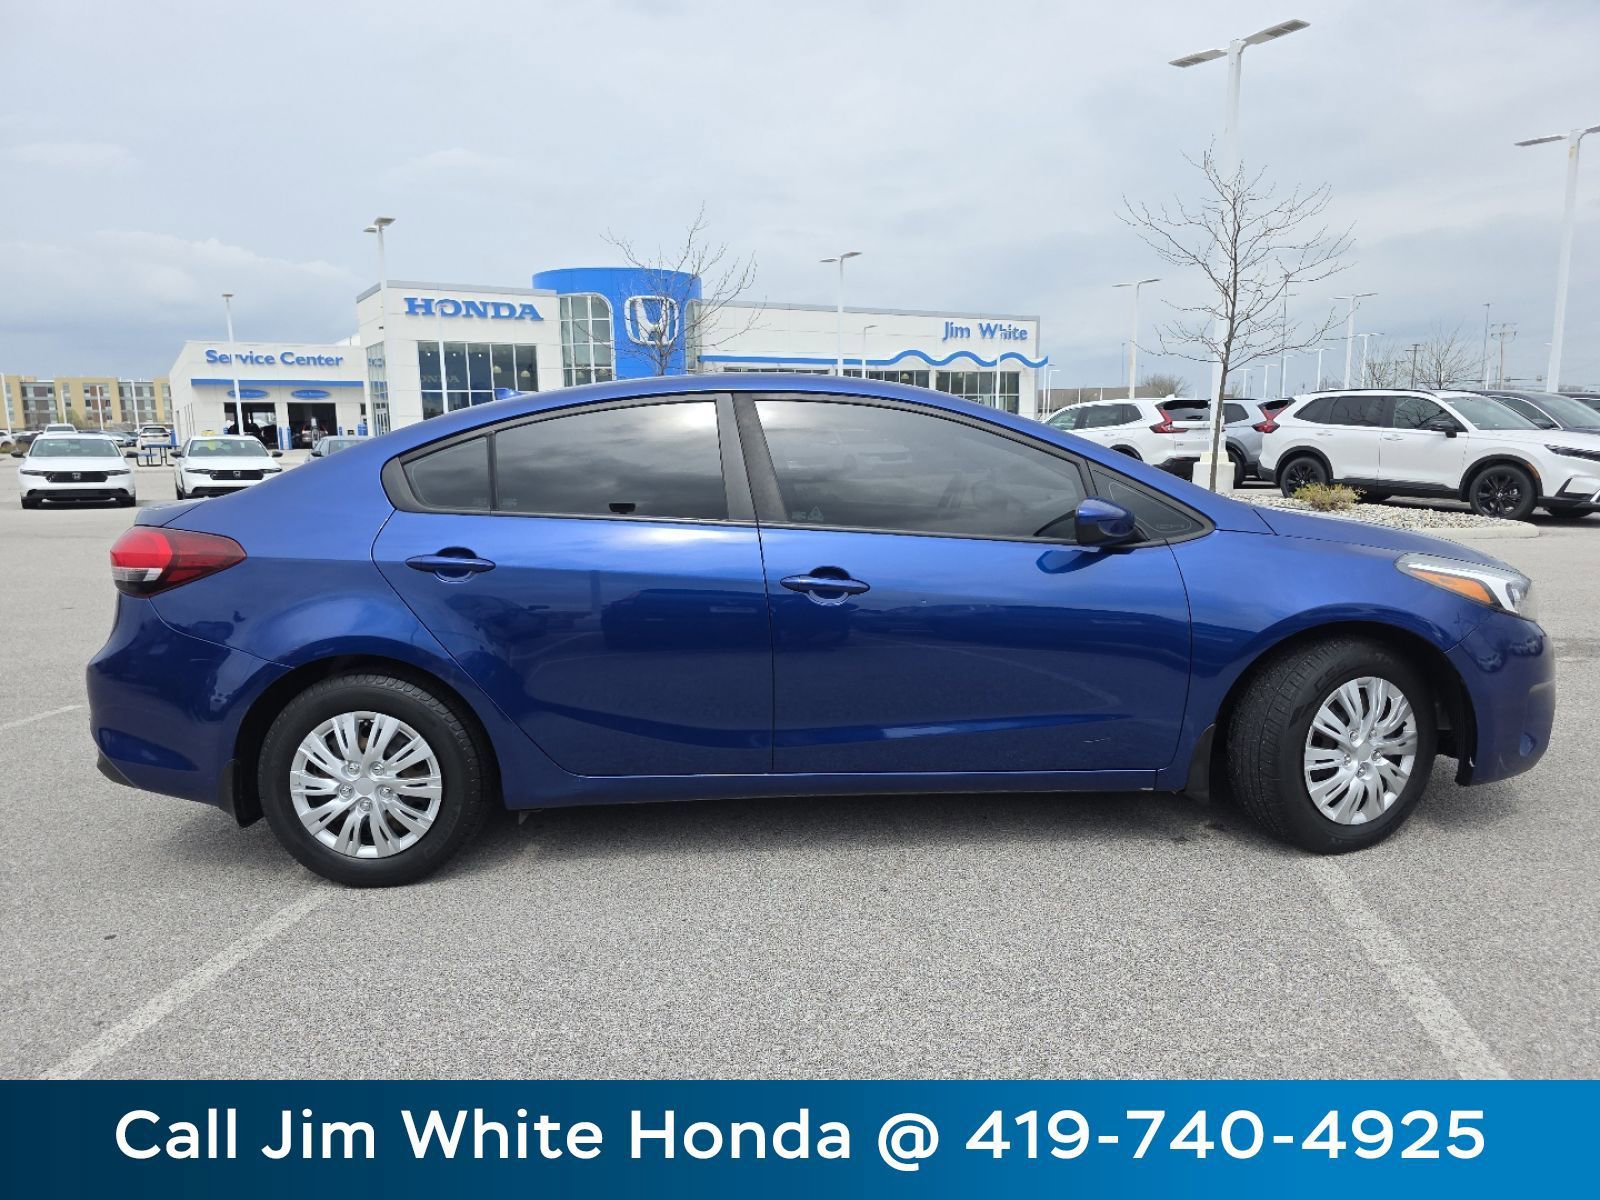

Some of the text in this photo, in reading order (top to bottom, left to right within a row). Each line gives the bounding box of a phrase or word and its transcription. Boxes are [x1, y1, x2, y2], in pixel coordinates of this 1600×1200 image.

[403, 297, 544, 321] HONDA
[942, 321, 1028, 342] Jim White
[280, 351, 344, 366] Center
